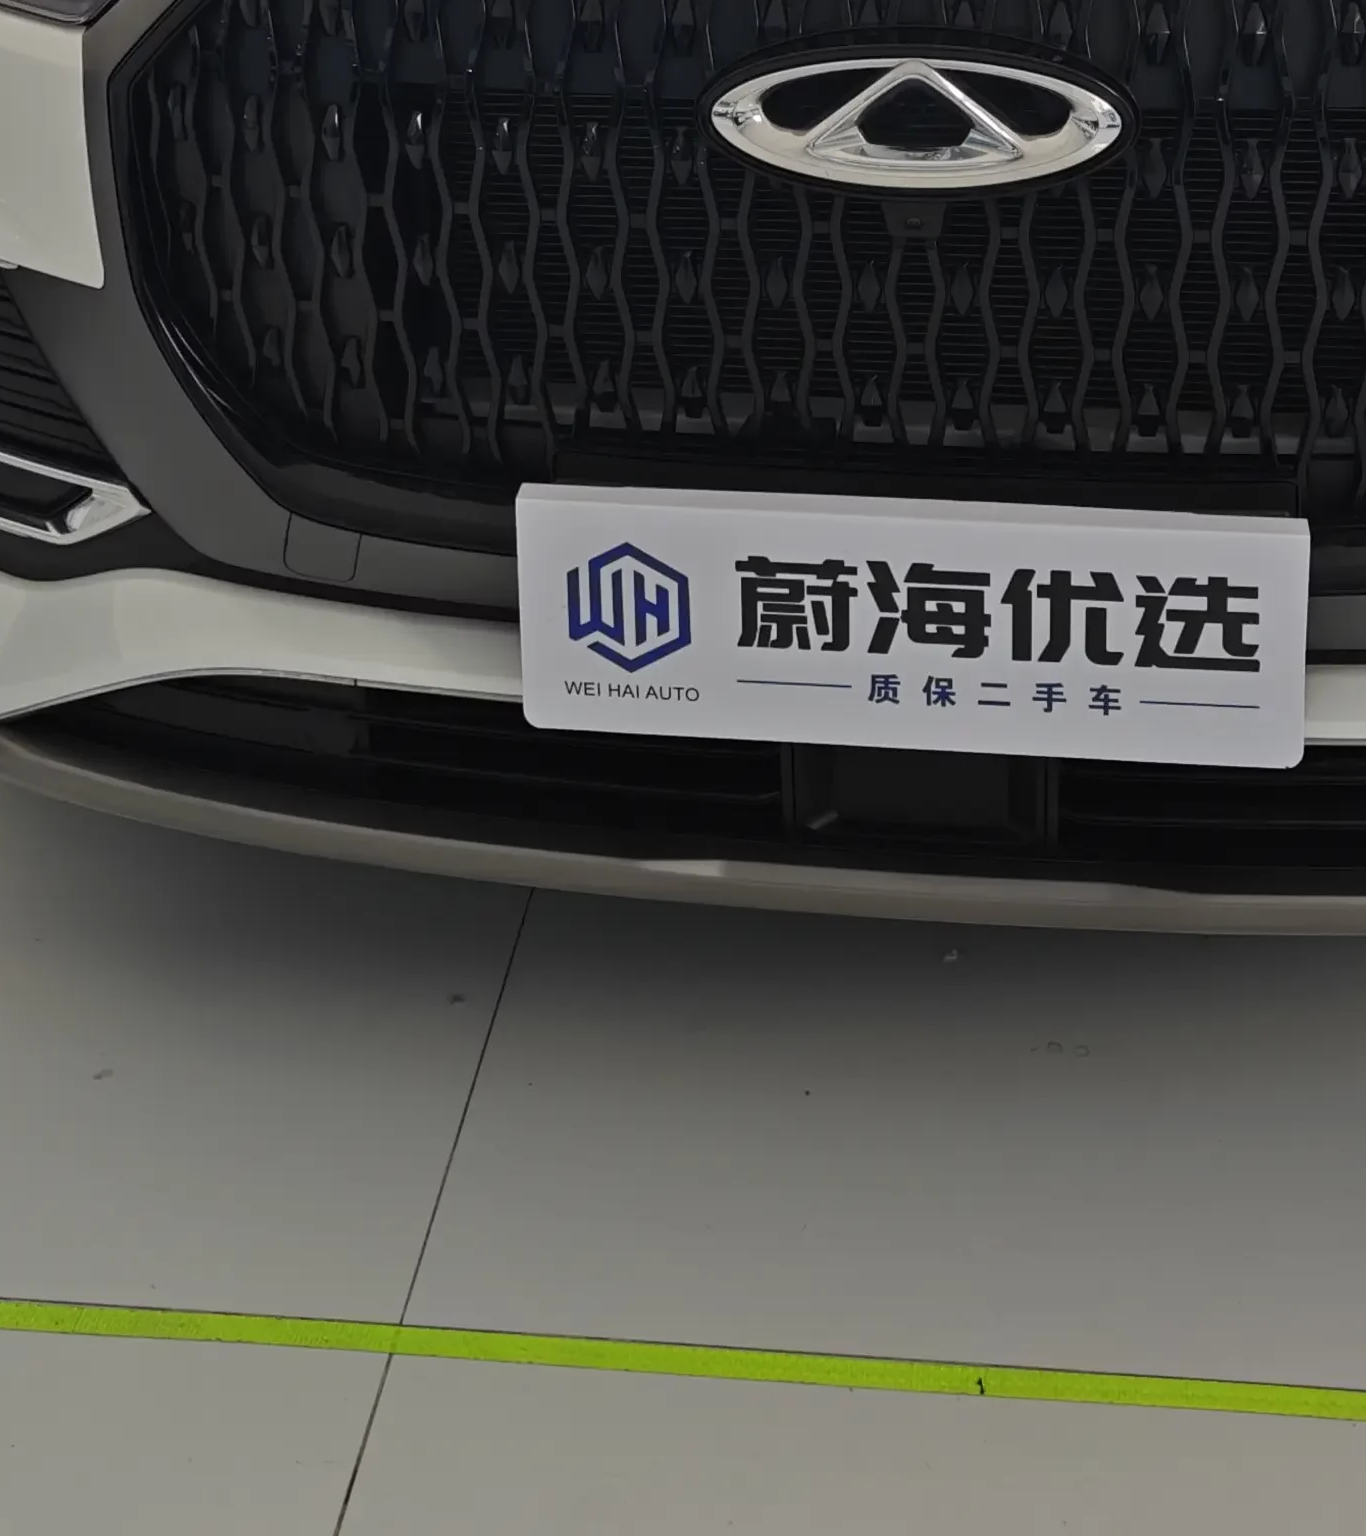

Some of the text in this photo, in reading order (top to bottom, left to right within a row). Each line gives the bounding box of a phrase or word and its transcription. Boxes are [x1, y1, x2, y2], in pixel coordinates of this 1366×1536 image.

[734, 554, 1262, 674] 蔚海优选
[564, 680, 700, 702] WEI HAI AUTO
[866, 674, 1123, 717] 质保二手车
